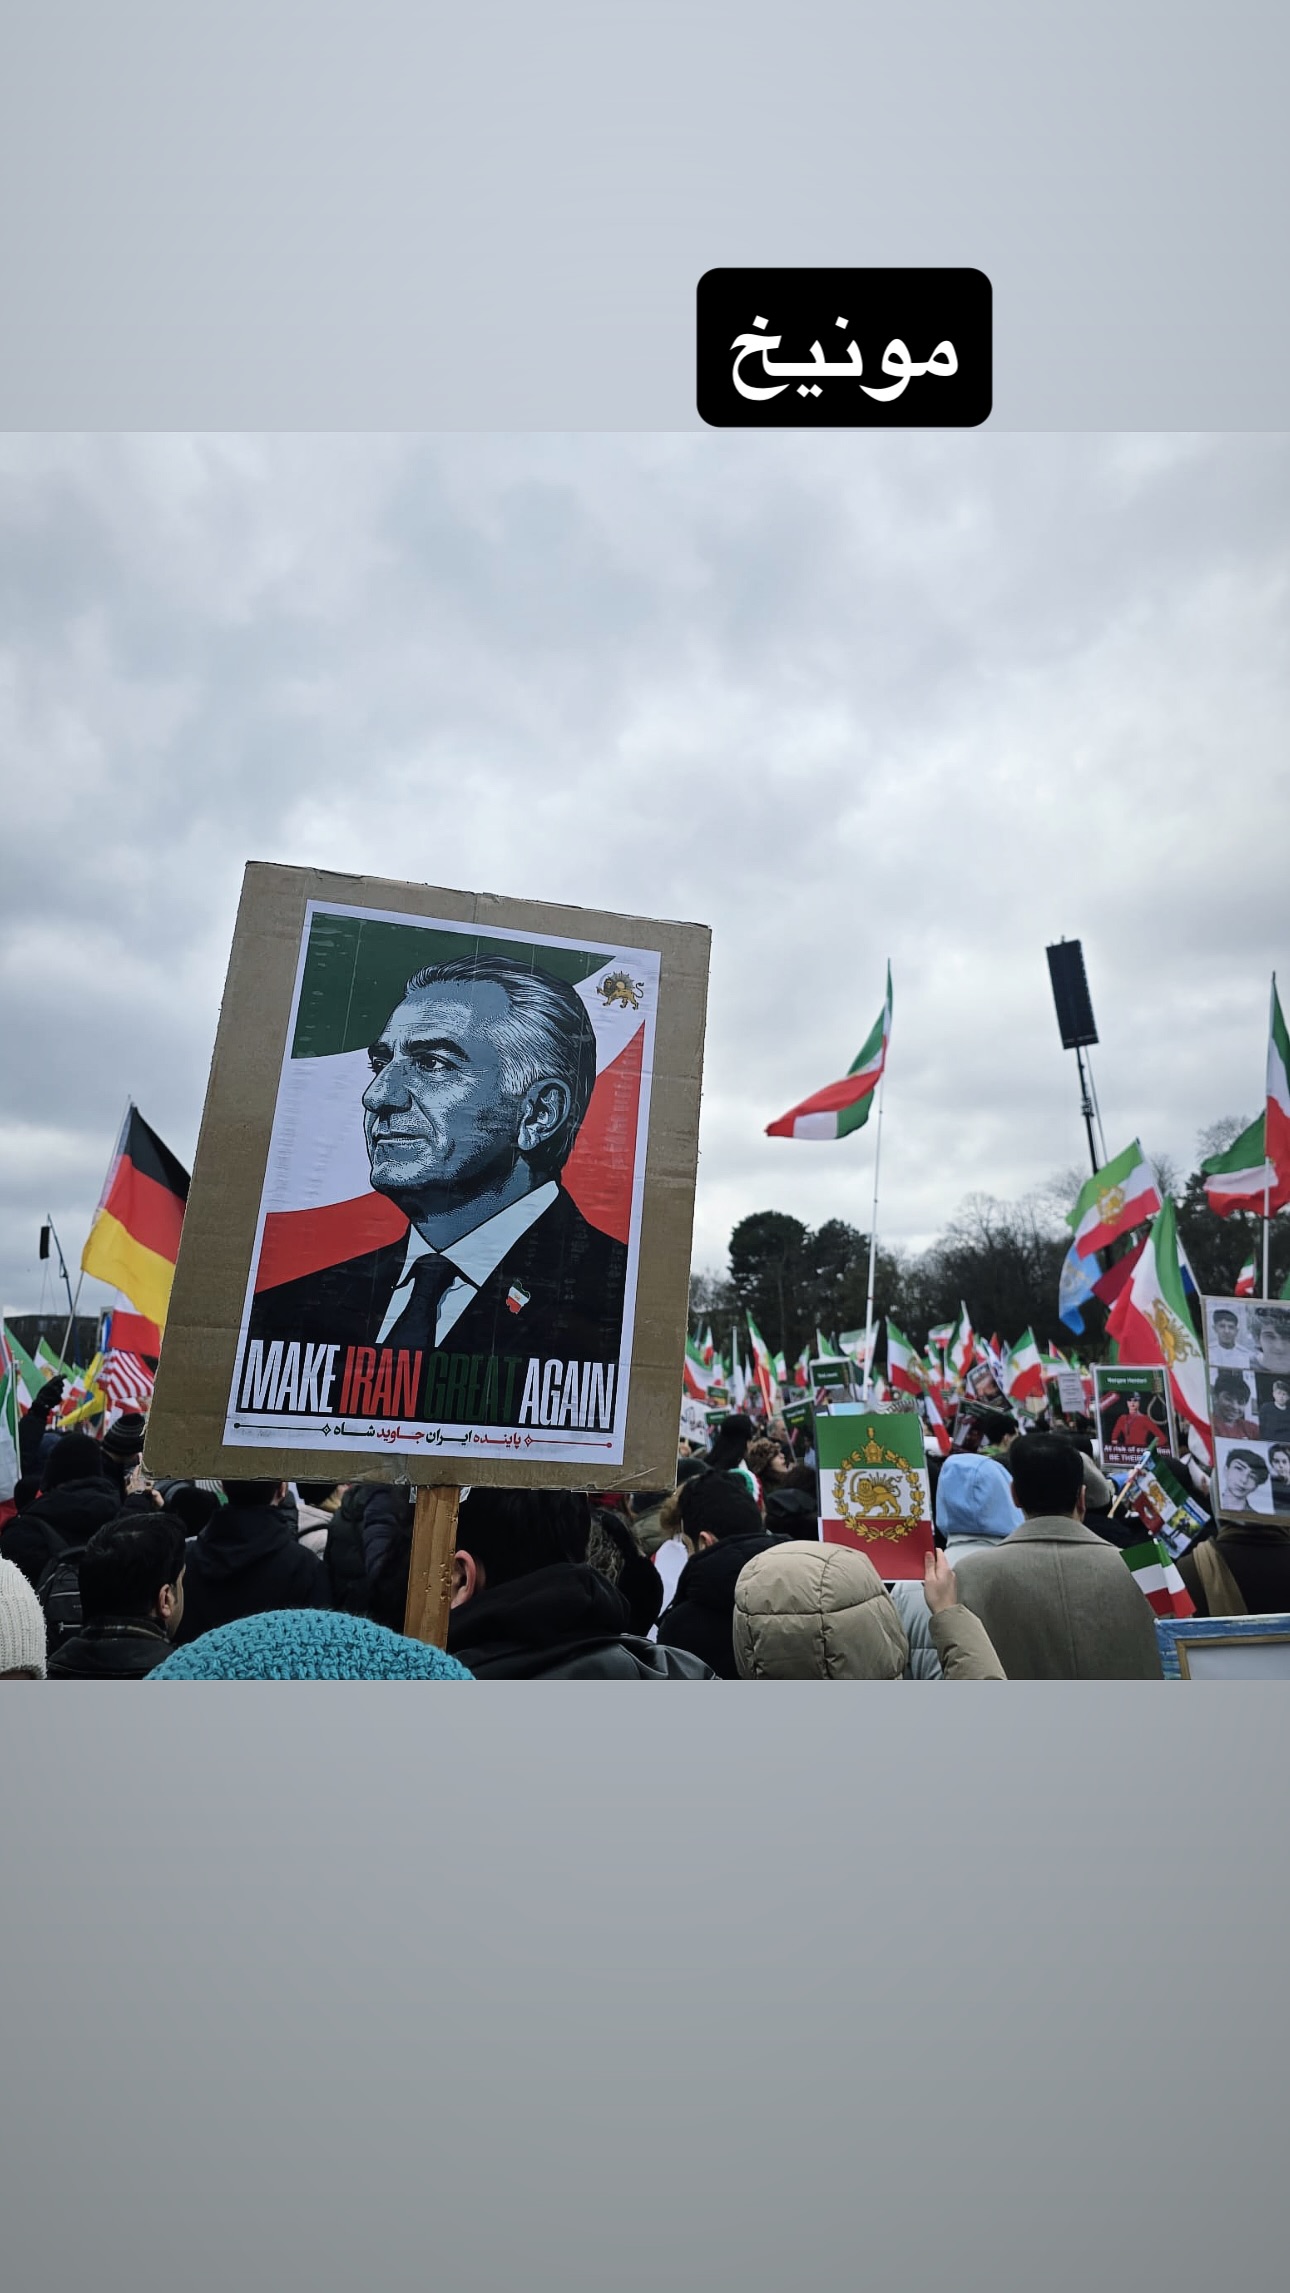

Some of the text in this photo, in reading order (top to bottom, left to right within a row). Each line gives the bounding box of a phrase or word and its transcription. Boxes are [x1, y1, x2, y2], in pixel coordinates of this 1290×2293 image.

[241, 1339, 340, 1413] MAKE
[339, 1345, 422, 1418] IRAN
[423, 1351, 522, 1424] GREAT
[518, 1357, 615, 1430] AGAIN
[333, 1421, 521, 1450] پاینده ایران جاوید شاه
